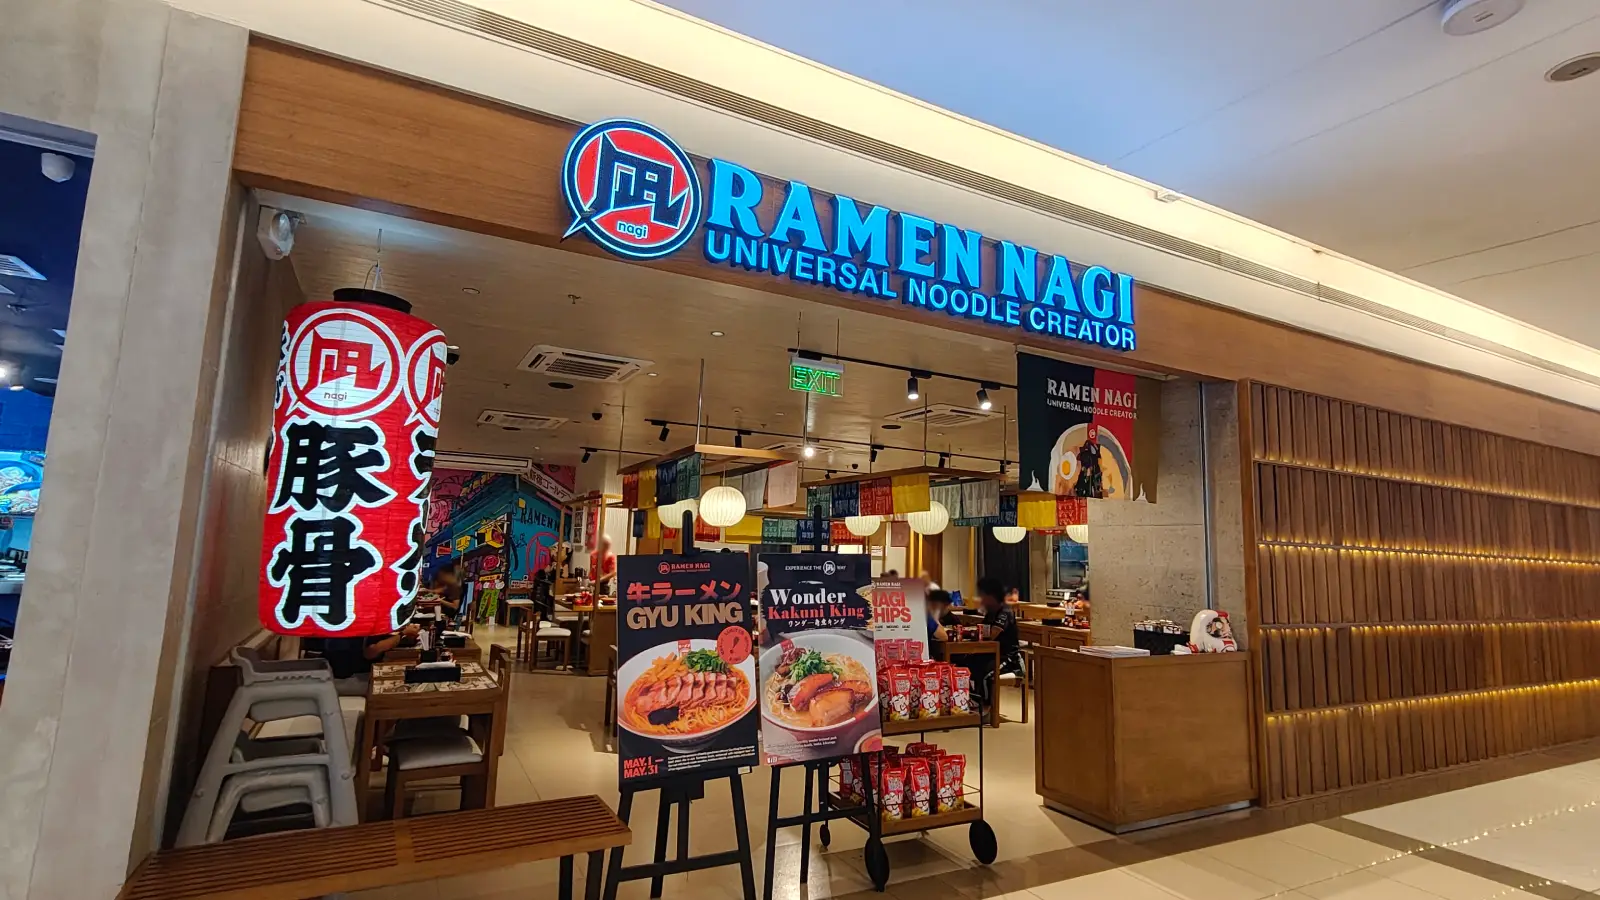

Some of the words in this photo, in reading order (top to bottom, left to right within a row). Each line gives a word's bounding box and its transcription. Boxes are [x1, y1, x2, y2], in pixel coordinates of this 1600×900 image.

[617, 221, 648, 239] nagi
[706, 158, 983, 288] RAMEN
[1000, 240, 1134, 325] NAGI
[707, 230, 897, 299] UNIVERSAL
[908, 278, 1020, 326] NOODLE
[1029, 307, 1136, 350] CREATOR
[793, 365, 841, 394] EXIT
[323, 391, 348, 402] nagi
[1047, 378, 1100, 403] RAMEN
[1104, 388, 1138, 410] NAGI
[1047, 398, 1082, 412] UNIVERSAL
[1083, 405, 1109, 416] NOODLE
[1109, 408, 1137, 420] CREATOR
[270, 419, 395, 627] 豚骨
[520, 503, 553, 529] RAMEN
[671, 562, 694, 570] RAMEN
[626, 580, 741, 604] 牛ラーメン
[769, 588, 847, 605] Wonder
[626, 605, 679, 630] GYU
[684, 602, 743, 626] KING
[768, 605, 825, 619] Kakuni
[830, 604, 865, 619] King
[873, 607, 912, 623] HIPS
